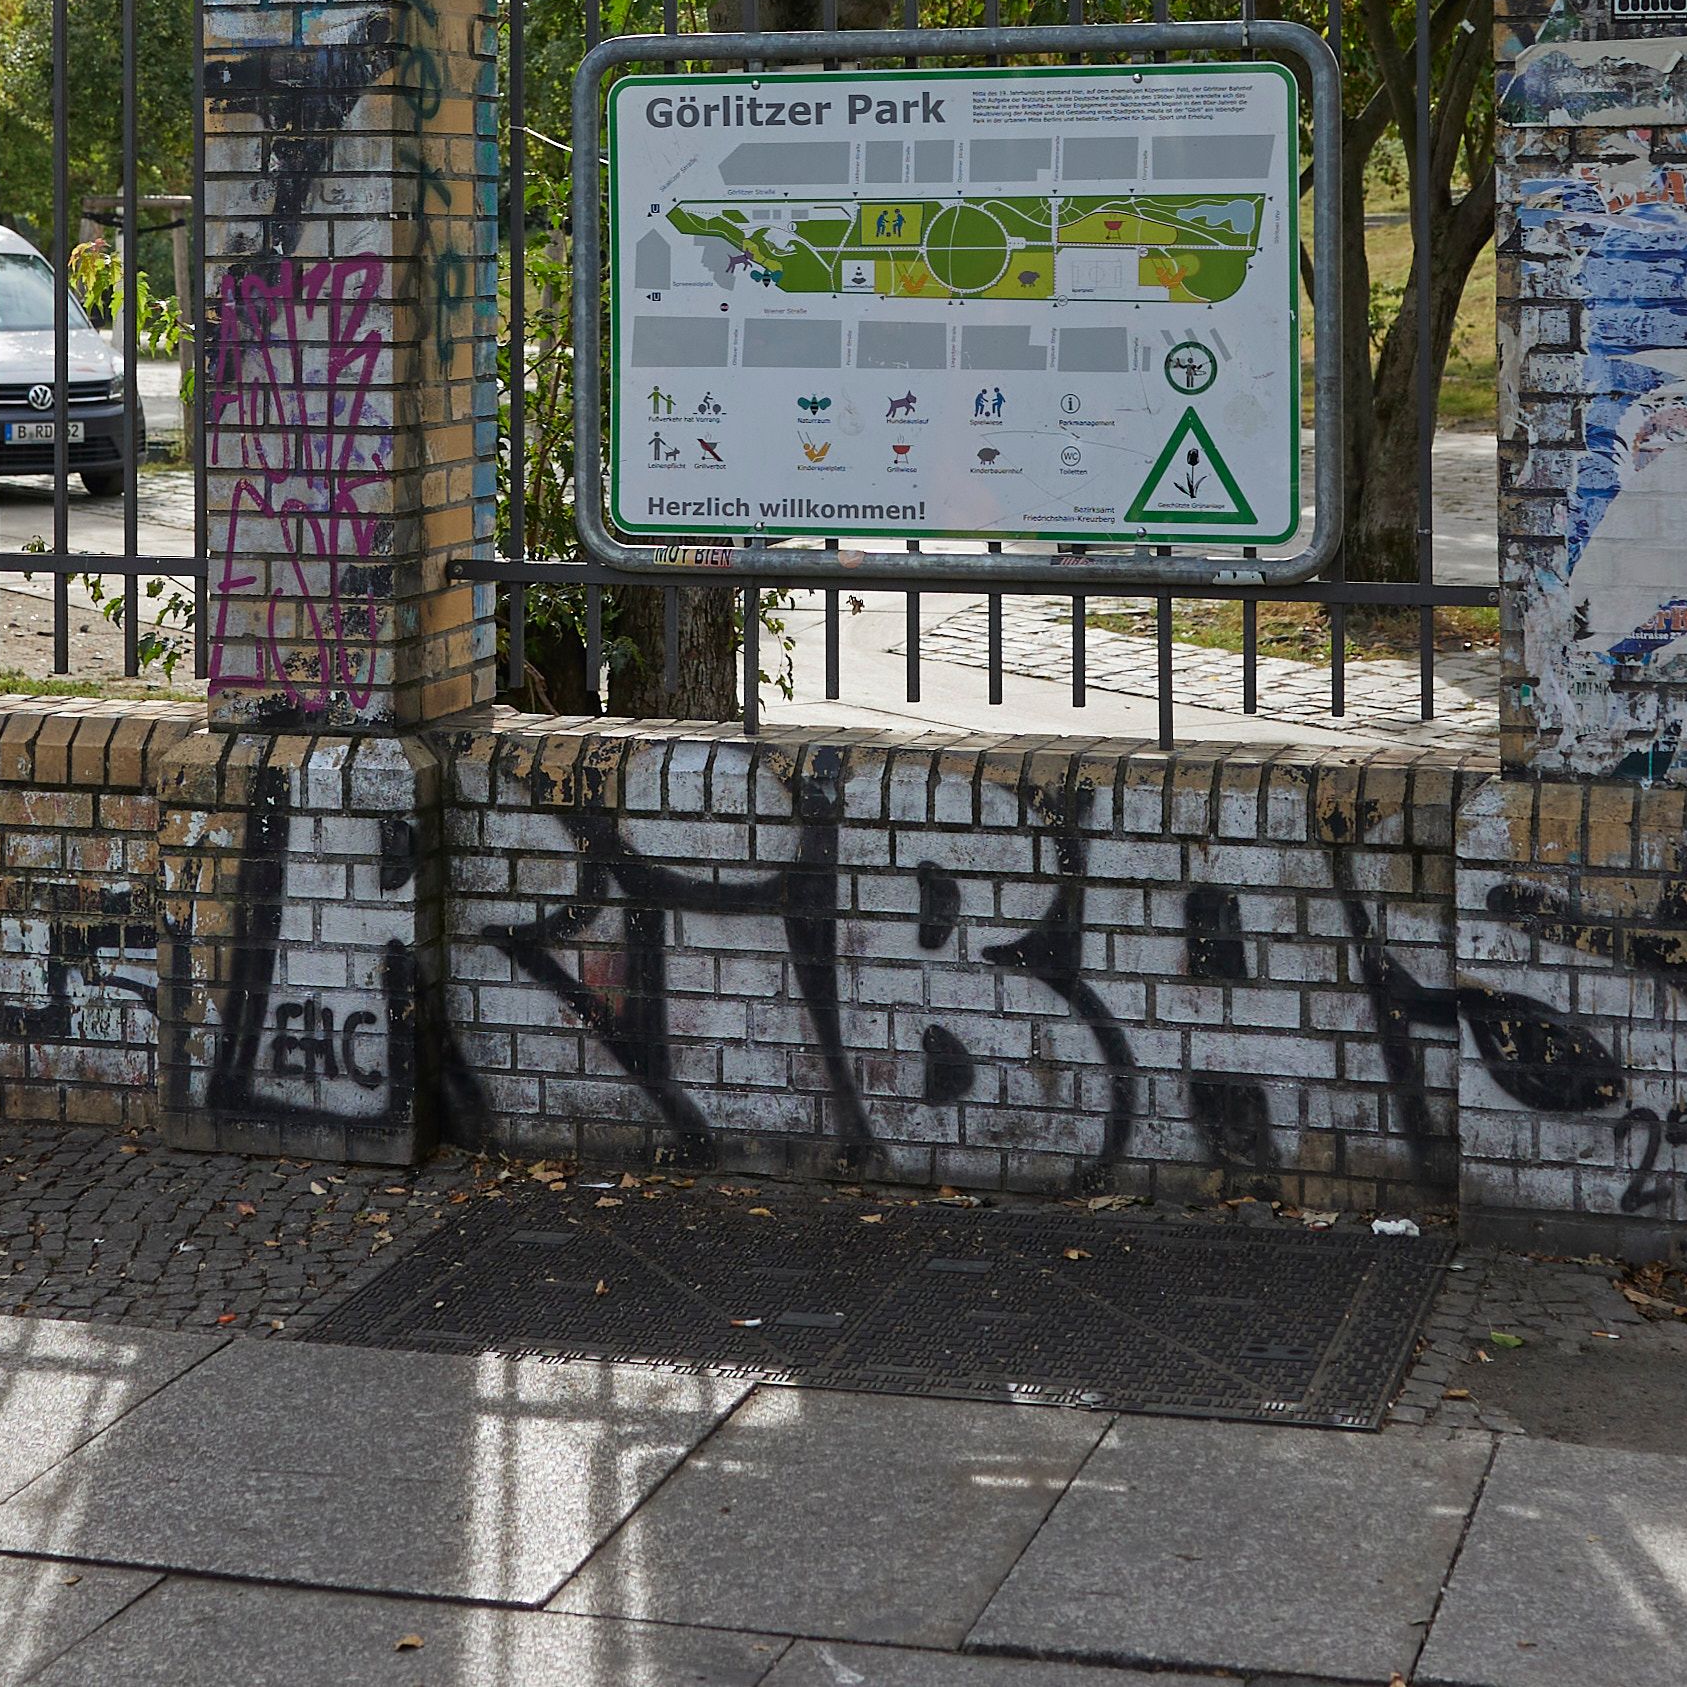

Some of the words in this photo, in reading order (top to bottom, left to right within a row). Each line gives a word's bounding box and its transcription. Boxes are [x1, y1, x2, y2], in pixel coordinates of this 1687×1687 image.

[646, 94, 832, 128] Görlitzer
[847, 91, 946, 125] Park
[727, 188, 753, 197] Görlitzer
[754, 188, 776, 196] Straße
[787, 307, 808, 315] Straße
[886, 417, 929, 425] Hundeauslauf
[969, 419, 1003, 427] Spielwiese
[1058, 419, 1115, 428] Parkmanagement
[18, 425, 27, 439] B
[35, 425, 53, 438] RD
[1063, 452, 1079, 461] WC
[648, 462, 686, 471] Leinenpflicht
[694, 462, 727, 471] Grillverbot
[797, 464, 847, 473] Kinderspielplatz
[886, 465, 918, 473] Grillwiese
[969, 466, 1023, 475] Kinderbauernhof
[1059, 468, 1088, 476] Toiletten
[648, 496, 750, 517] Herzlich
[759, 498, 926, 521] willkommen!
[1073, 506, 1115, 514] Bezirksamt
[1157, 501, 1190, 510] Geschützte
[1023, 514, 1116, 524] Friedrichshain-Kreuzberg
[694, 548, 733, 566] BIEN
